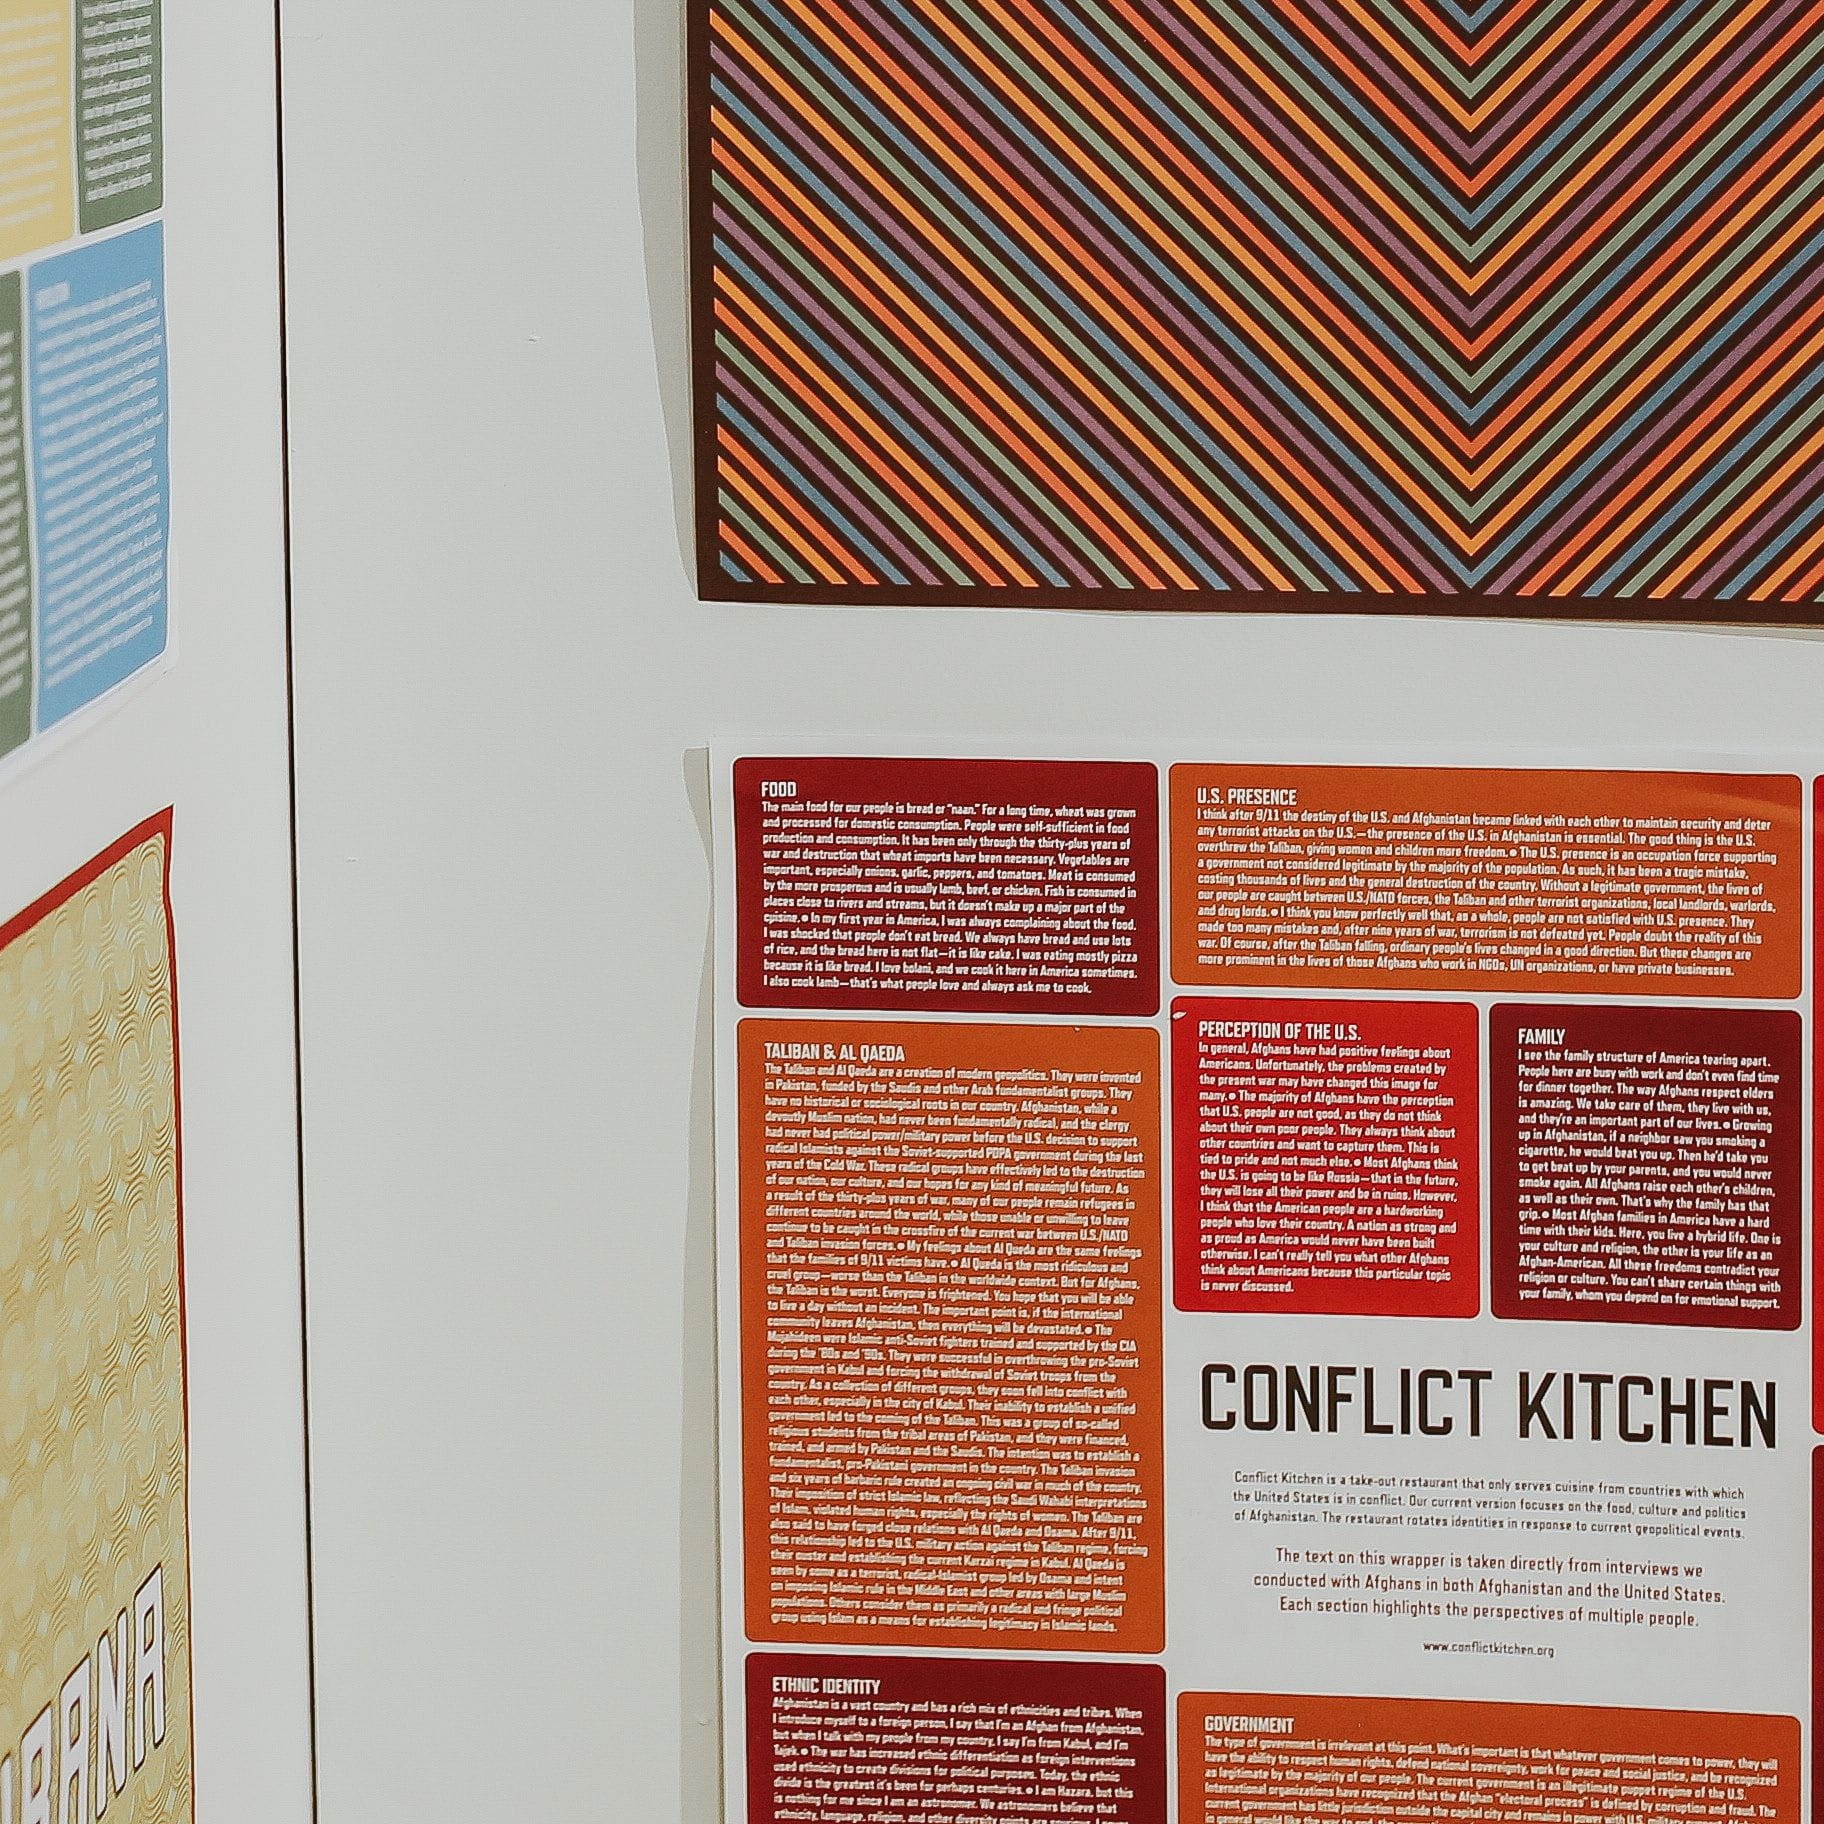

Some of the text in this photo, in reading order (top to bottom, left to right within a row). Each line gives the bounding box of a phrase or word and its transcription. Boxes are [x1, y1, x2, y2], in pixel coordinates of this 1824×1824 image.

[761, 782, 796, 797] FOOD
[1197, 787, 1297, 806] U.S. PRESENCE
[1199, 1021, 1362, 1040] PERCEPTION OF THE U.S.
[1518, 1028, 1566, 1045] FAMILY
[764, 1042, 905, 1064] TALIBAN & AL QAEDA
[1518, 1048, 1770, 1069] I see the family structure of America tearing apart.
[1200, 1278, 1292, 1292] is never discussed.
[1201, 1362, 1776, 1450] CONFLICT KITCHEN
[1234, 1470, 1745, 1499] Conflict Kitchen is a take-out restaurant that only serves cuisine from countries with which
[1233, 1489, 1746, 1521] the United States is in conflict. Our current version focuses on the food, culture and politics
[1234, 1508, 1745, 1539] of Afghanistan. The restaurant rotates identities in response to current geopolitical events.
[1277, 1545, 1703, 1577] The text on this wrapper is taken directly from interviews we
[1253, 1569, 1725, 1602] conducted with Afghans in both Afghanistan and the United States.
[1280, 1595, 1699, 1629] Each section highlights the perspectives of multiple people.
[1422, 1638, 1555, 1659] www.conflictkitchen.org
[772, 1677, 881, 1695] ETHNIC IDENTITY
[1204, 1715, 1294, 1733] GOVERNMENT
